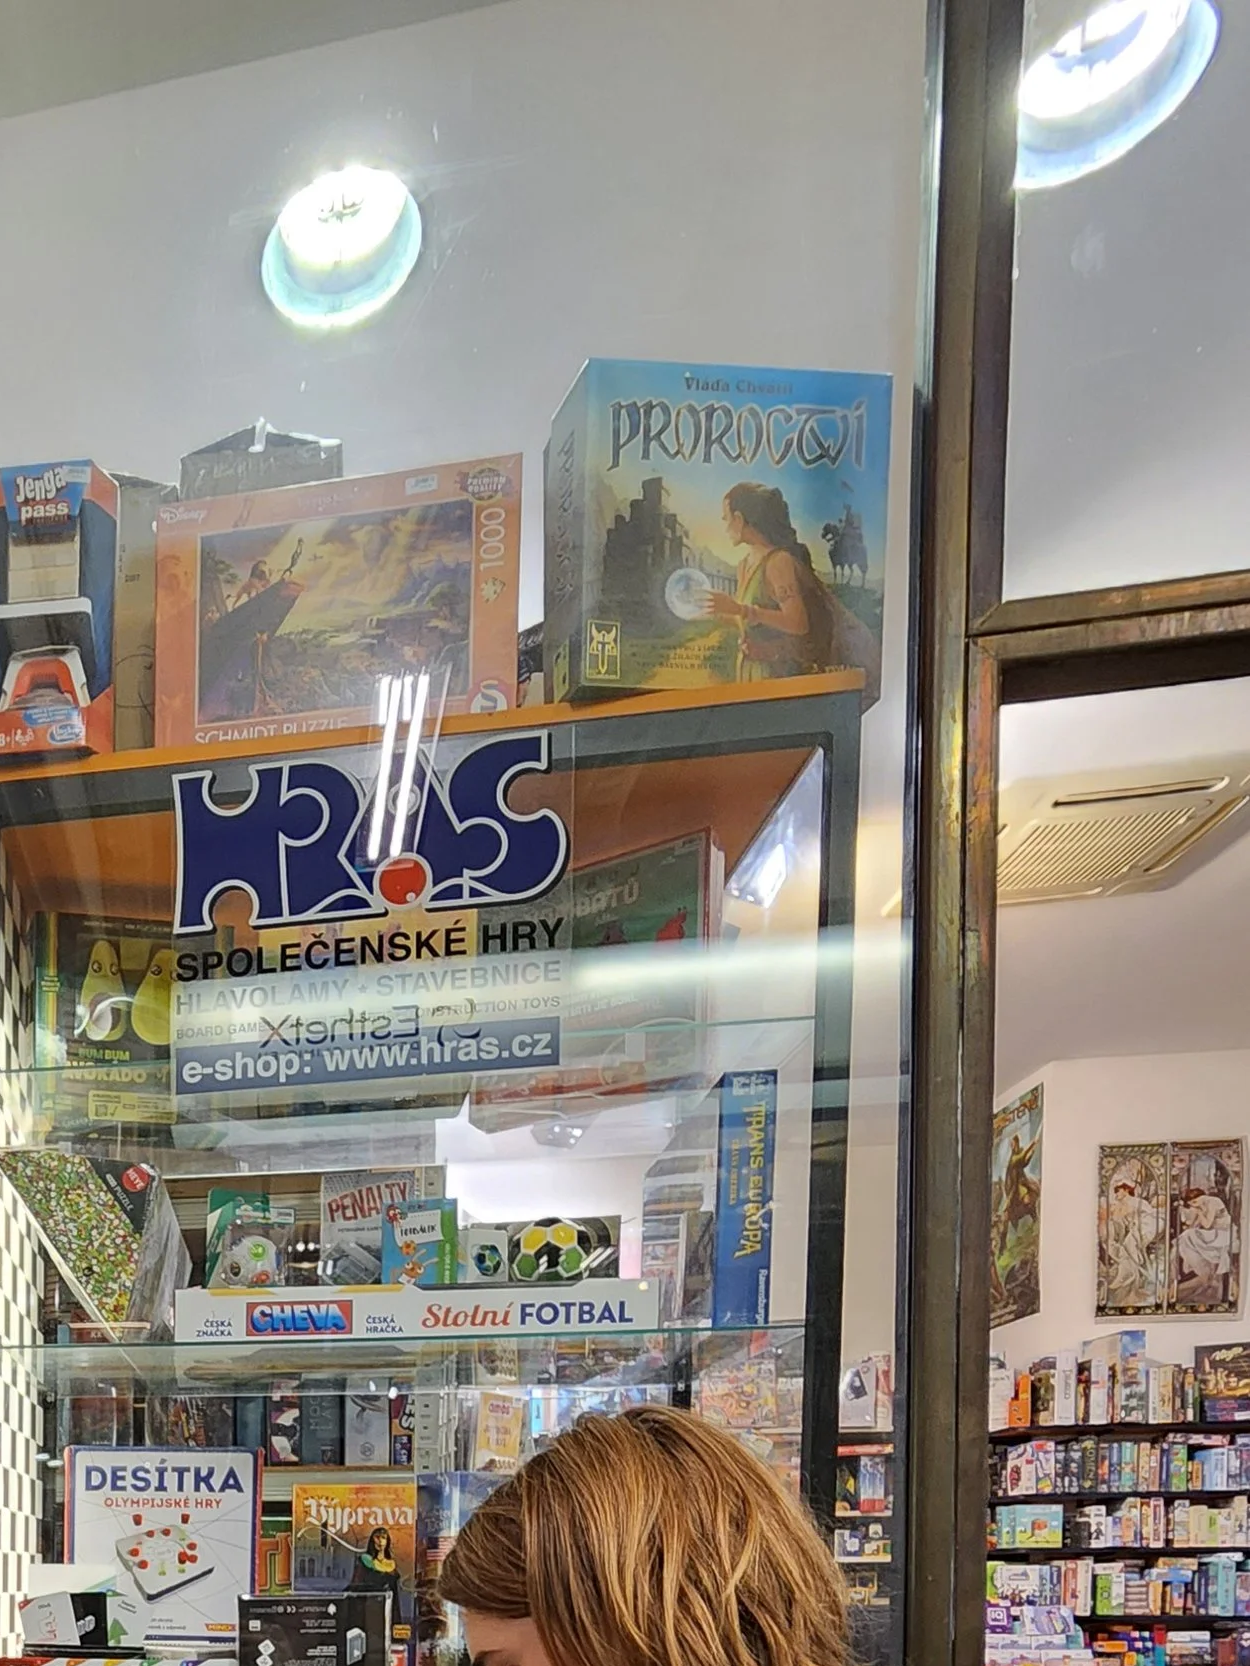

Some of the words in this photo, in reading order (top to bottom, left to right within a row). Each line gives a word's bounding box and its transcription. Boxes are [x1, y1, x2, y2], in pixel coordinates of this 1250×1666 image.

[15, 465, 69, 503] Jenga
[20, 501, 70, 526] pass
[160, 506, 207, 524] Disney
[479, 507, 507, 573] 1000
[176, 920, 468, 982] SPOLEČENSKÉ
[483, 917, 564, 954] HRY
[176, 978, 351, 1016] HLAVOLAMY
[376, 959, 562, 997] STAVEBNICE
[176, 1023, 224, 1040] BOARD
[521, 995, 561, 1011] TOYS
[181, 1052, 313, 1085] e-shop:
[323, 1030, 553, 1074] www.hras.cz
[742, 1100, 767, 1169] TRANS
[327, 1180, 409, 1224] PENALTY
[195, 1325, 233, 1338] ZNAČKA
[203, 1316, 233, 1329] ČESKÁ
[251, 1303, 348, 1335] CHEVA
[365, 1313, 396, 1325] ČESKÁ
[365, 1322, 404, 1335] HRAČKA
[421, 1300, 514, 1329] Stolní
[520, 1299, 635, 1329] FOTBAL
[84, 1457, 245, 1494] DESÍTKA
[103, 1495, 191, 1510] OLYMPIJSKÉ
[194, 1497, 223, 1510] HRY
[303, 1496, 415, 1535] Výprava
